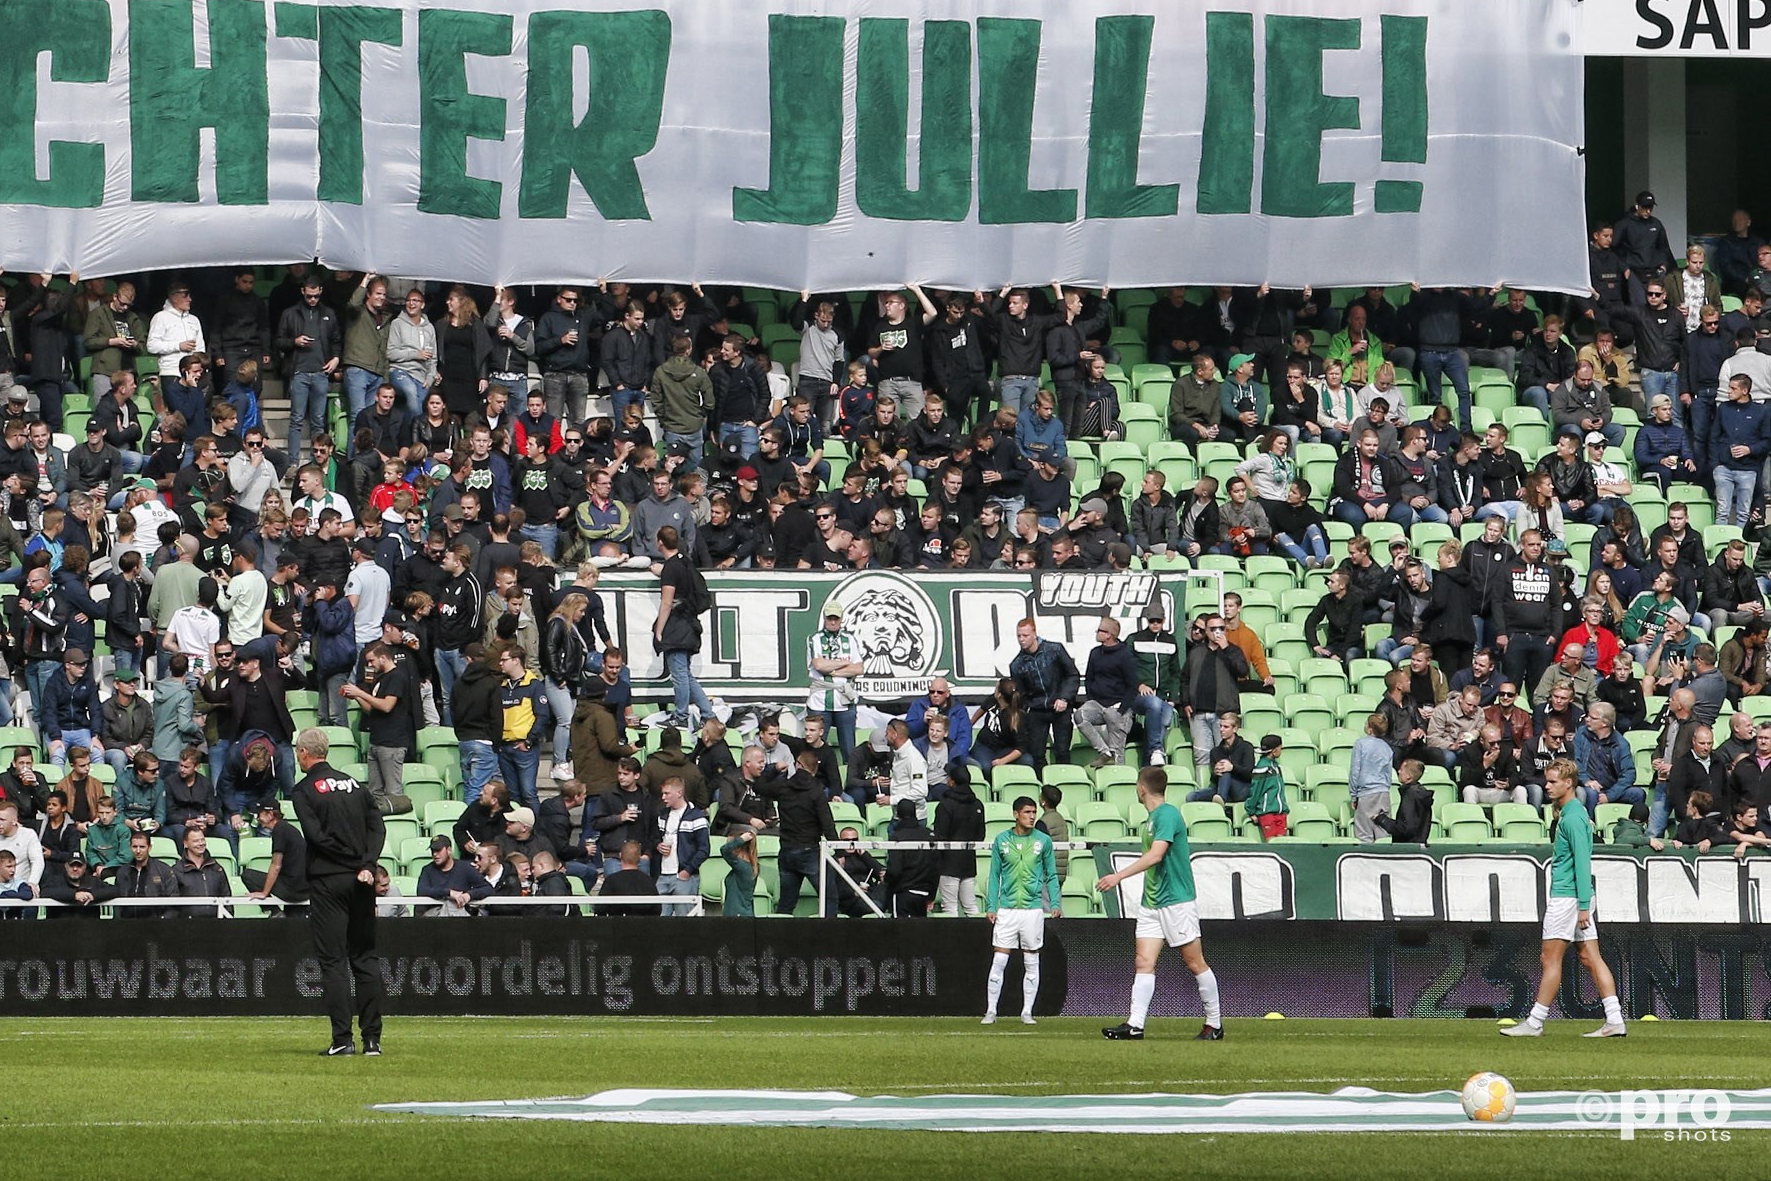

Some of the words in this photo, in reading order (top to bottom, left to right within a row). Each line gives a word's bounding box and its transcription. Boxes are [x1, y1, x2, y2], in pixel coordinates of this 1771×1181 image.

[732, 10, 1429, 225] JULLIE!
[1042, 573, 1150, 608] YOUTH
[1514, 582, 1549, 593] denim
[1514, 592, 1546, 603] wear
[379, 939, 634, 1011] voordelig
[651, 945, 937, 1011] ontstoppen
